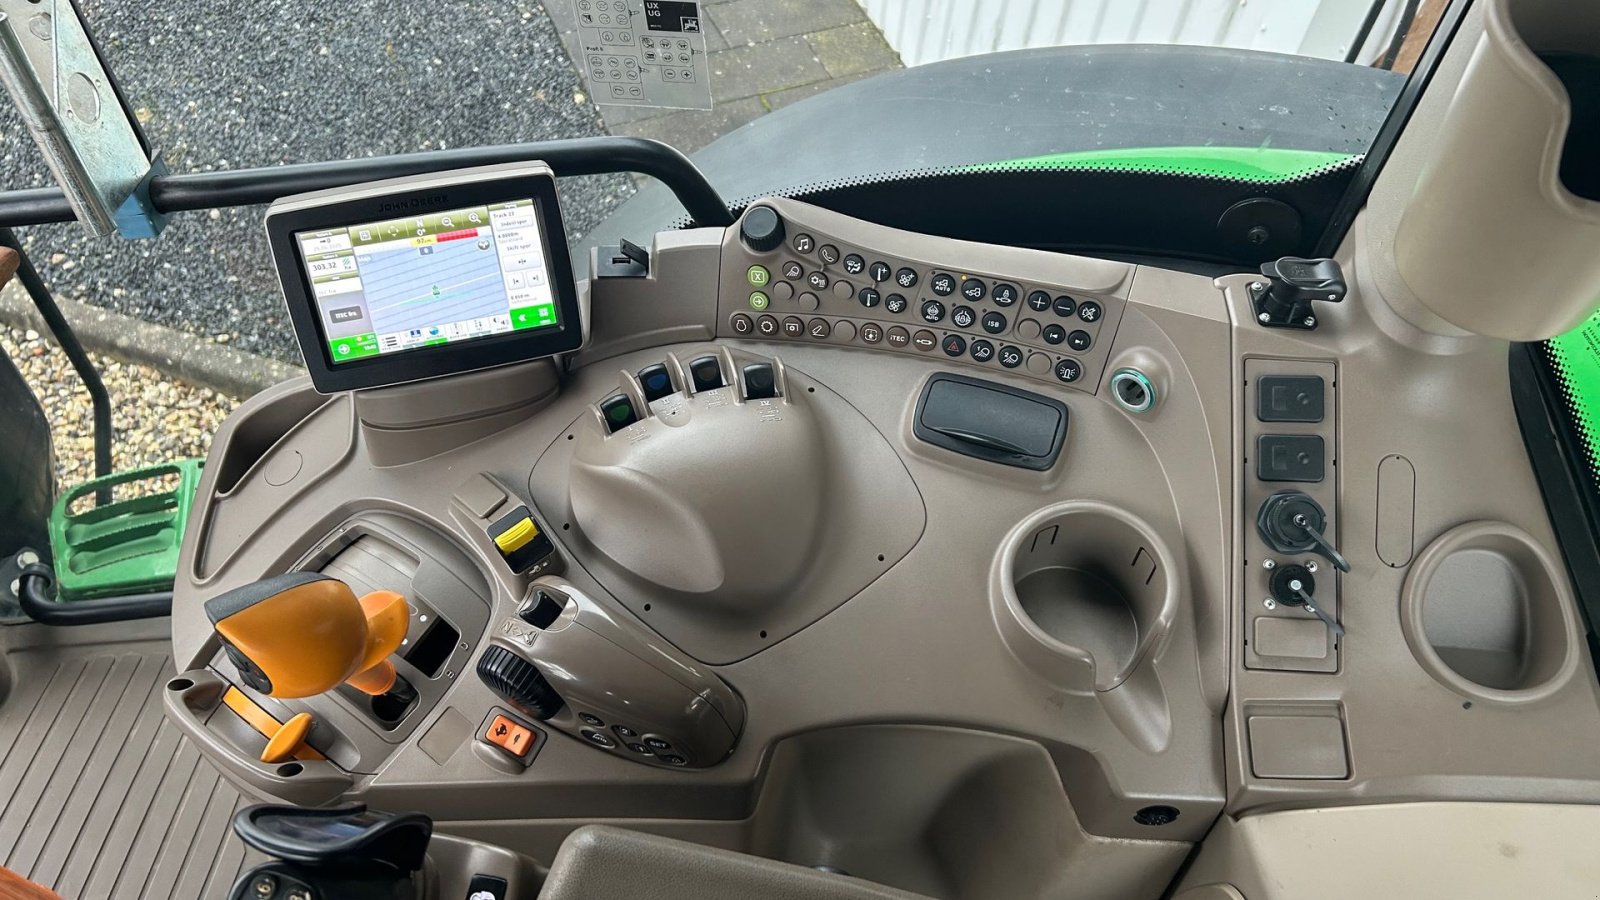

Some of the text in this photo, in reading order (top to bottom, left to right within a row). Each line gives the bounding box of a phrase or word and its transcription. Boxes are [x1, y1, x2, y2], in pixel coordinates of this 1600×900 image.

[379, 195, 449, 213] JOHN DEERE
[312, 261, 337, 271] 303.32
[987, 320, 1000, 328] ISB
[890, 334, 905, 342] iTEC
[649, 740, 667, 748] SET
